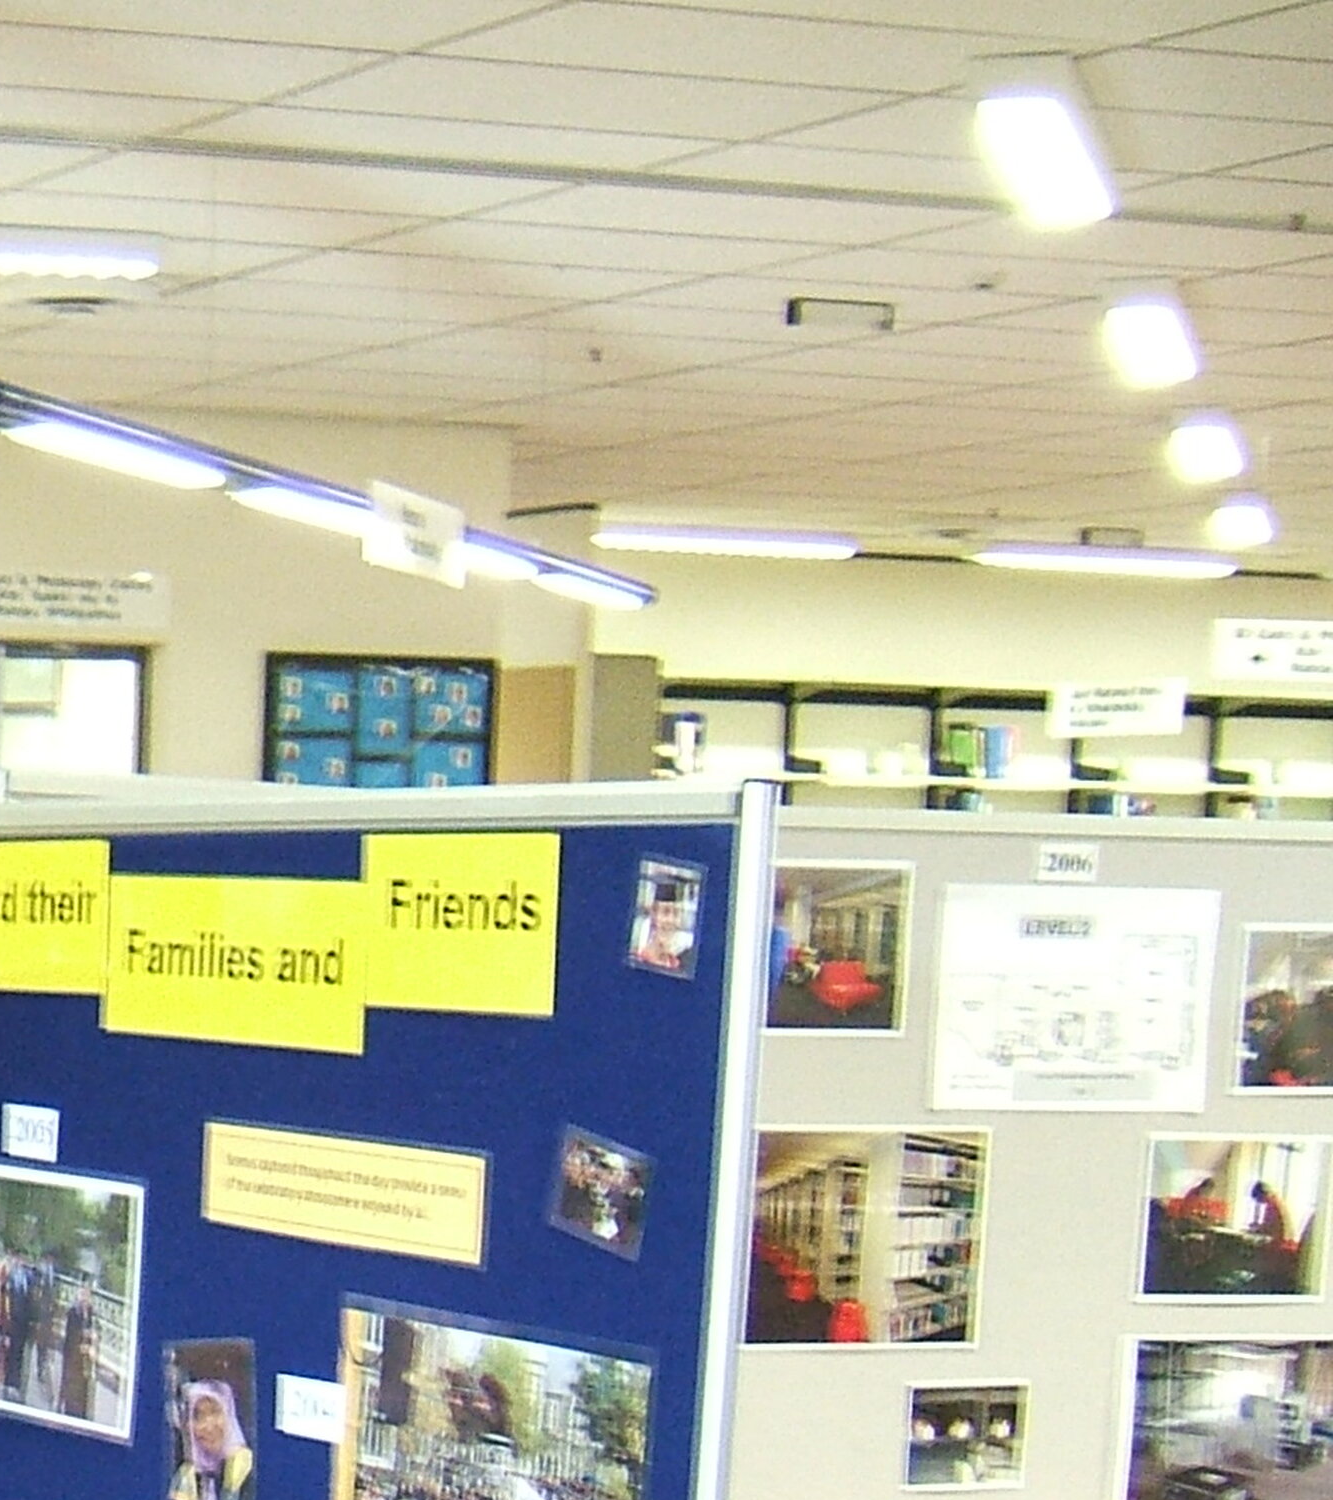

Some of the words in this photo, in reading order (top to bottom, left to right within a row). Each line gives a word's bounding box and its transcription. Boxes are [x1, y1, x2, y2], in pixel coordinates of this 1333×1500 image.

[26, 880, 96, 926] their
[388, 878, 542, 933] Friends
[126, 928, 264, 984] Families
[276, 937, 345, 988] and
